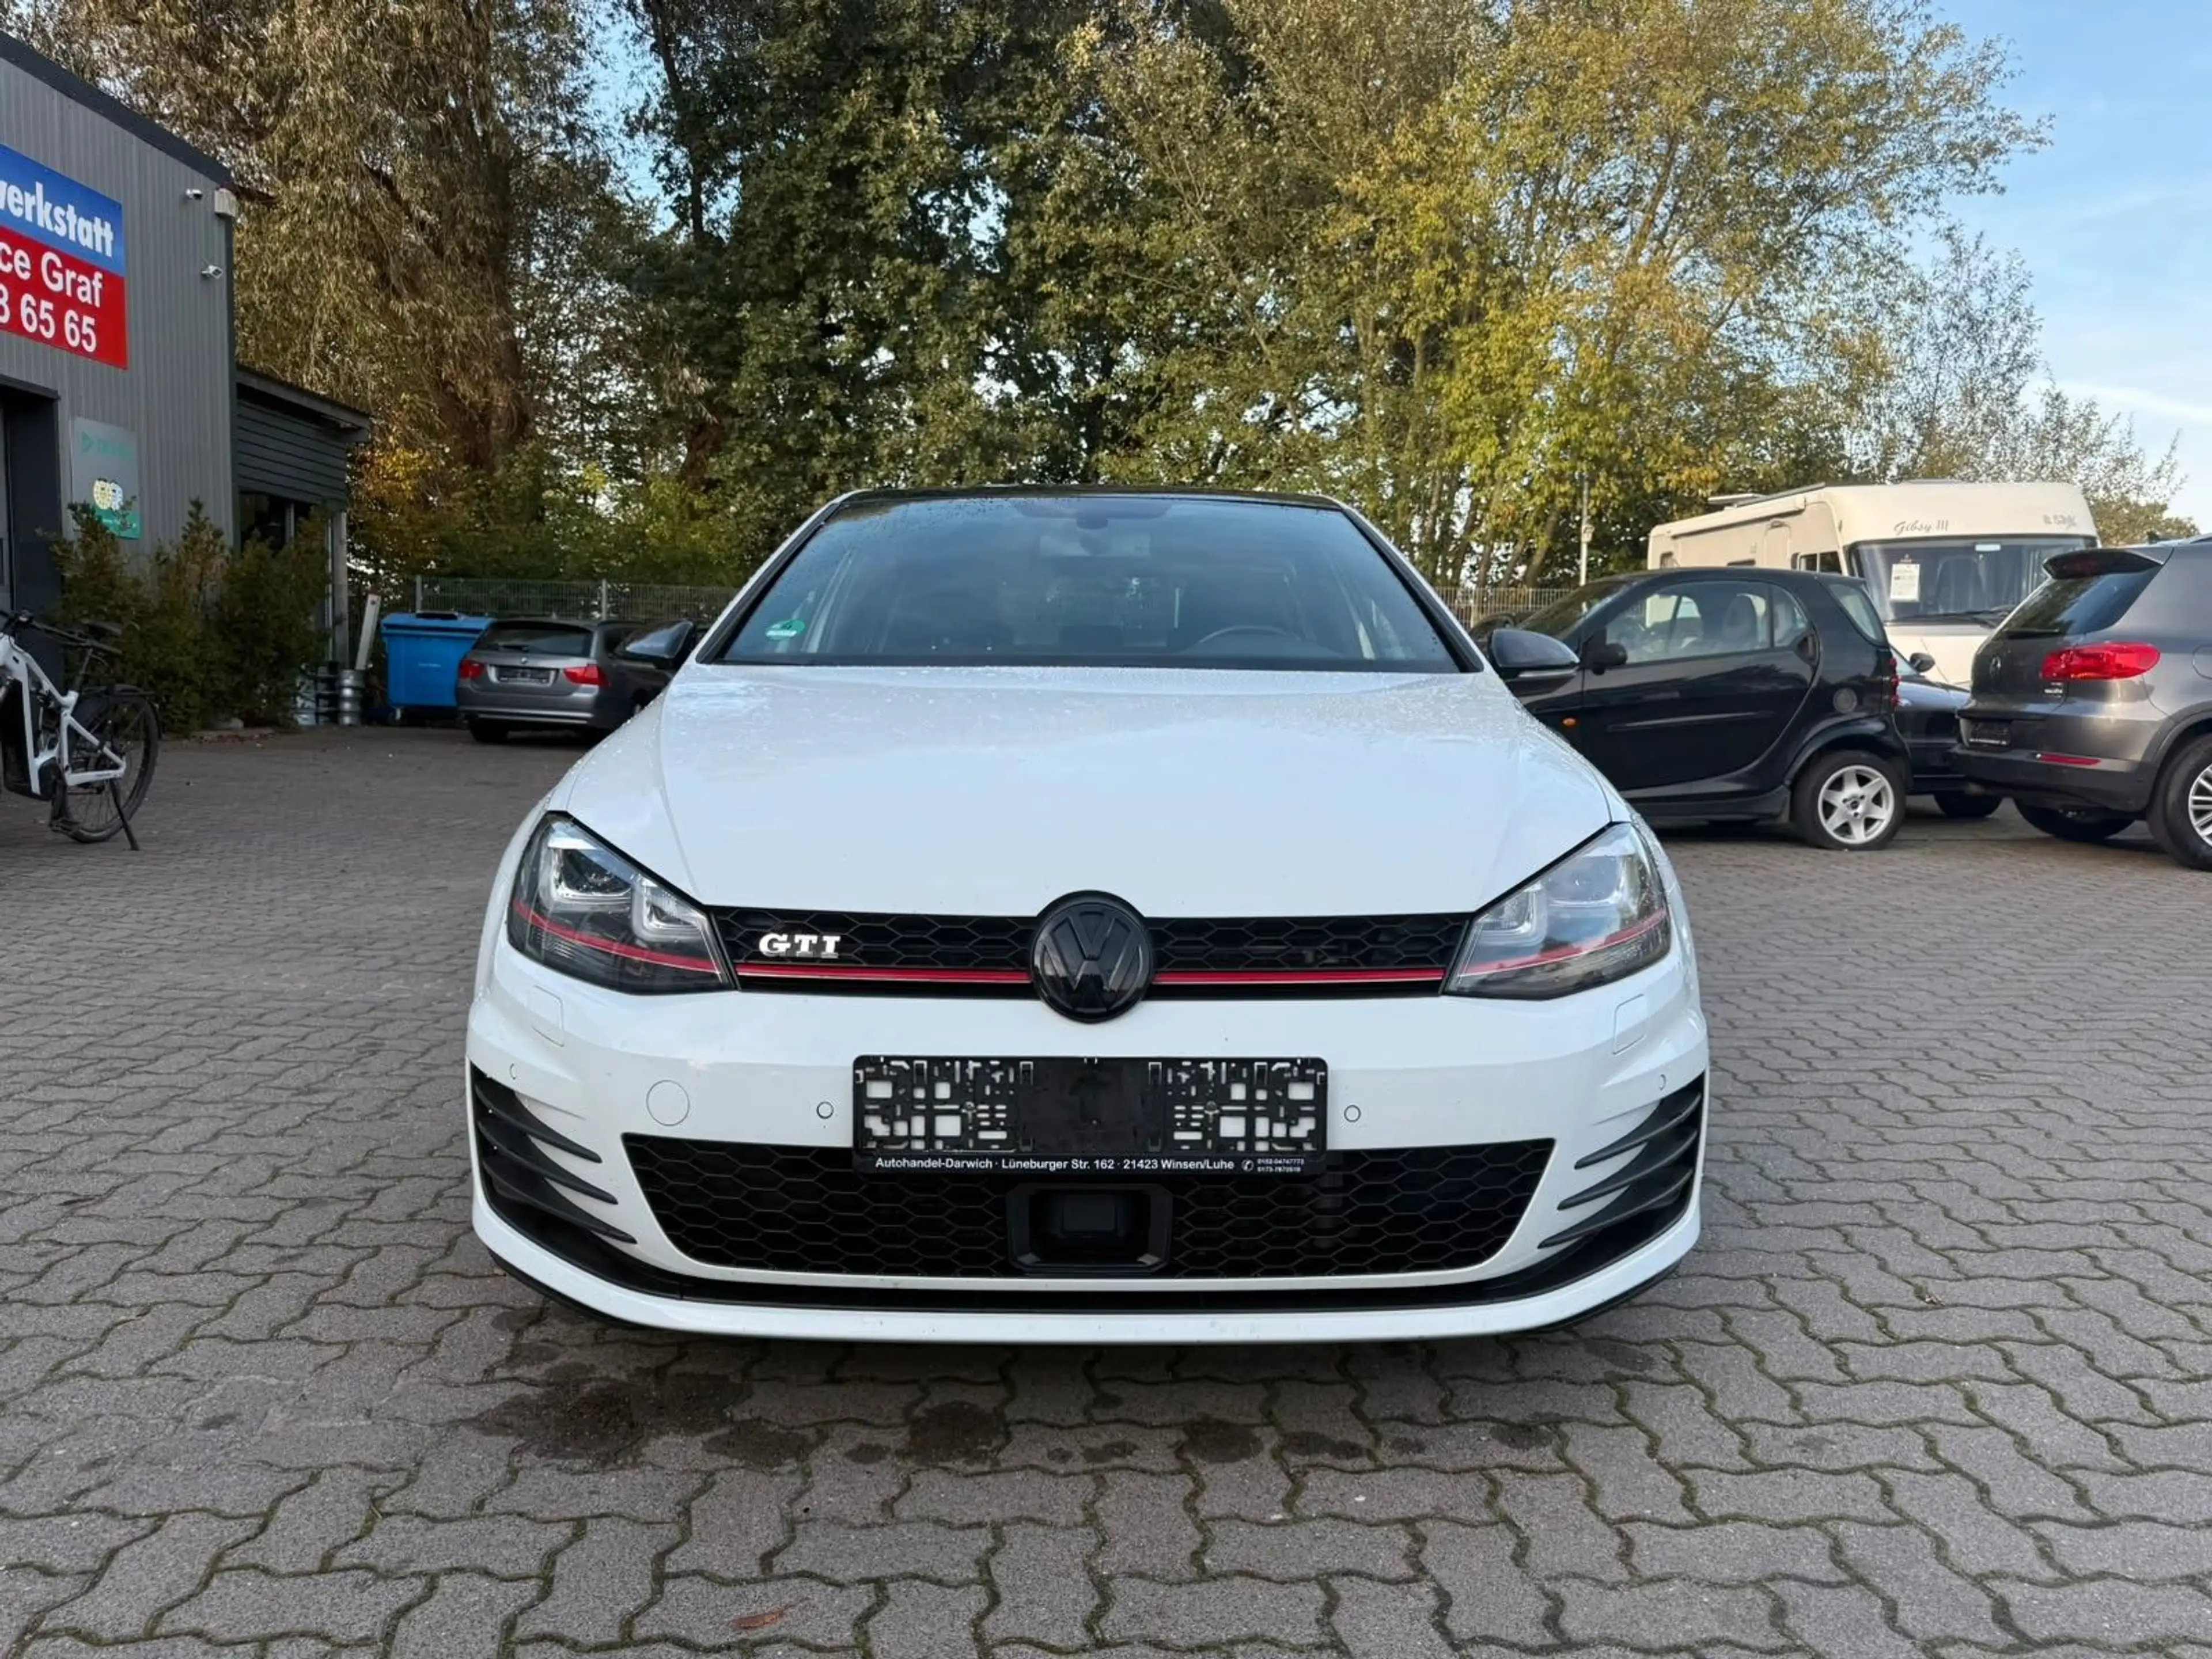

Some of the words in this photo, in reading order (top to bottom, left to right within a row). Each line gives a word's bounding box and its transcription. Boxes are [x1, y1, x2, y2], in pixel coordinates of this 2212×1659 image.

[41, 251, 103, 308] Graf
[21, 293, 55, 338] 65
[65, 309, 96, 352] 65
[759, 933, 841, 959] GTI
[875, 1157, 993, 1169] Autohandel-Darwich
[1002, 1158, 1068, 1171] Lüneburger
[1071, 1158, 1090, 1169] Str.
[1094, 1159, 1115, 1169] 162
[1123, 1159, 1159, 1169] 21423
[1161, 1159, 1234, 1170] Winsen/Luhe
